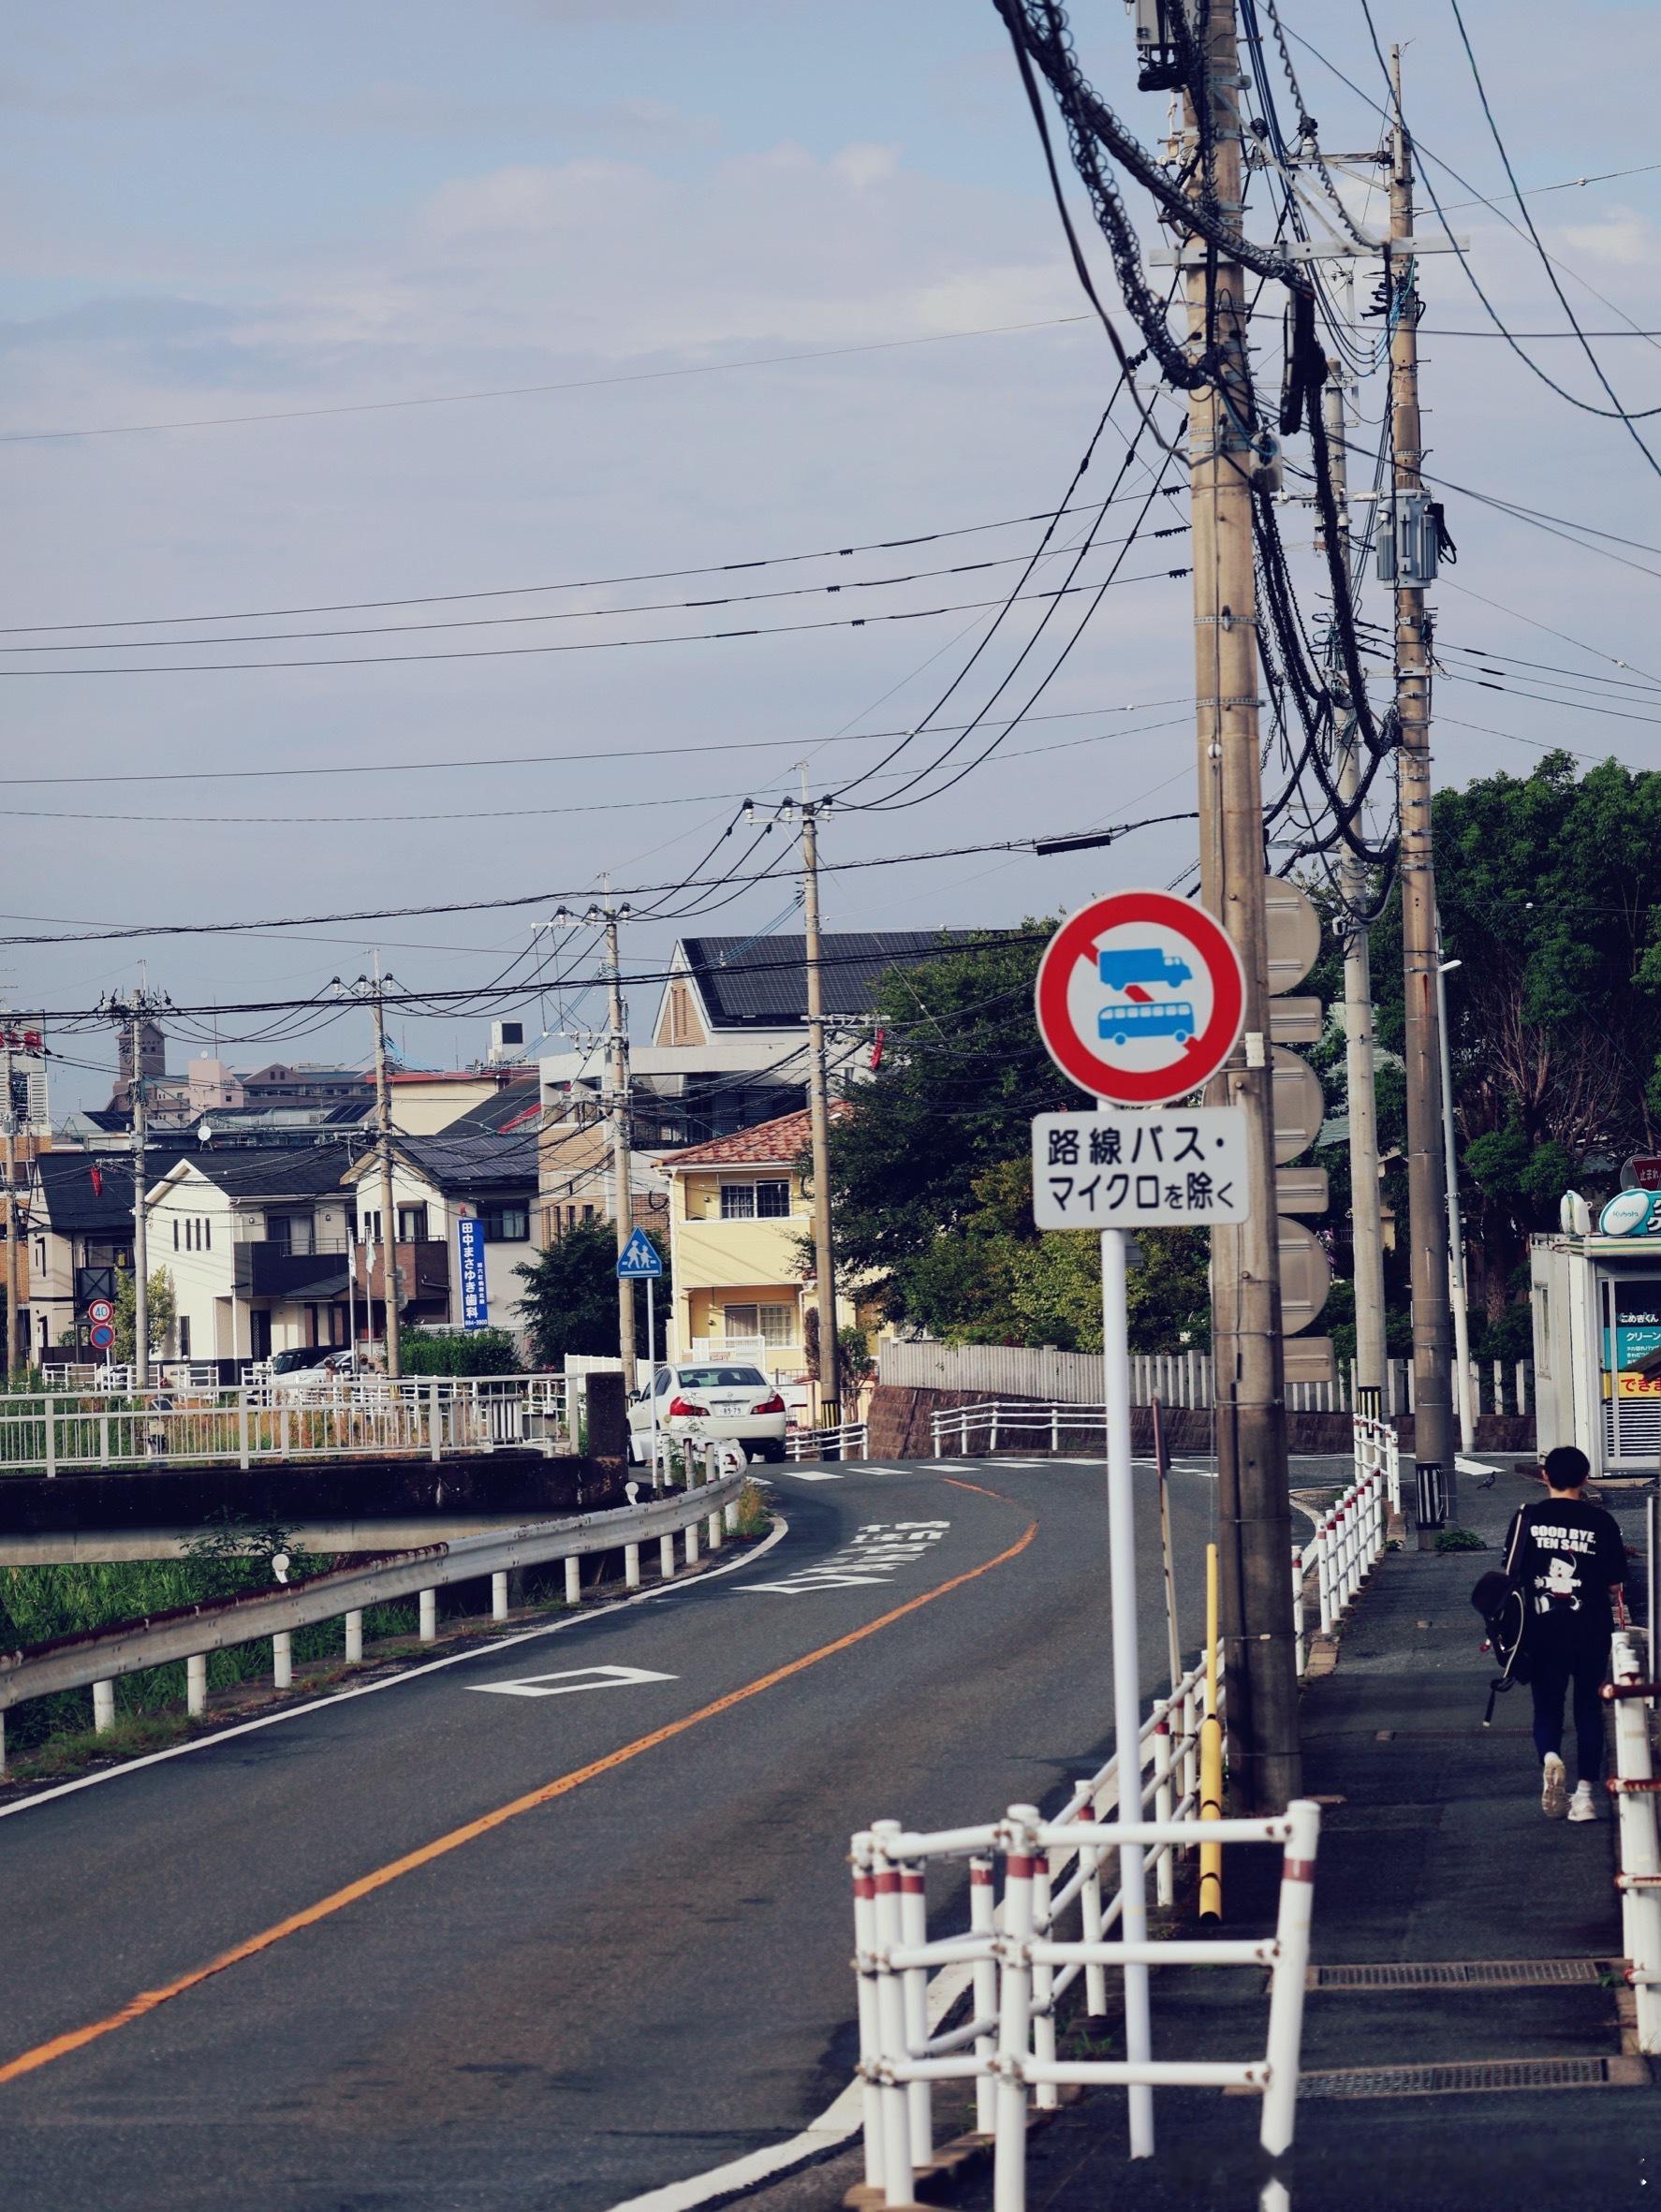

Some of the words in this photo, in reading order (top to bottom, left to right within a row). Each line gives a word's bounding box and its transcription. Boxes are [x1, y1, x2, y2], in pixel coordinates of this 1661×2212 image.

[1047, 1124, 1226, 1165] 路線バス・
[1639, 1168, 1659, 1180] 止まれ
[1048, 1171, 1234, 1211] マイクロを除く
[462, 1222, 478, 1319] 田中まさゆき歯科
[95, 1307, 108, 1318] 40
[1530, 1525, 1567, 1539] GOOD
[1535, 1536, 1559, 1549] TEN
